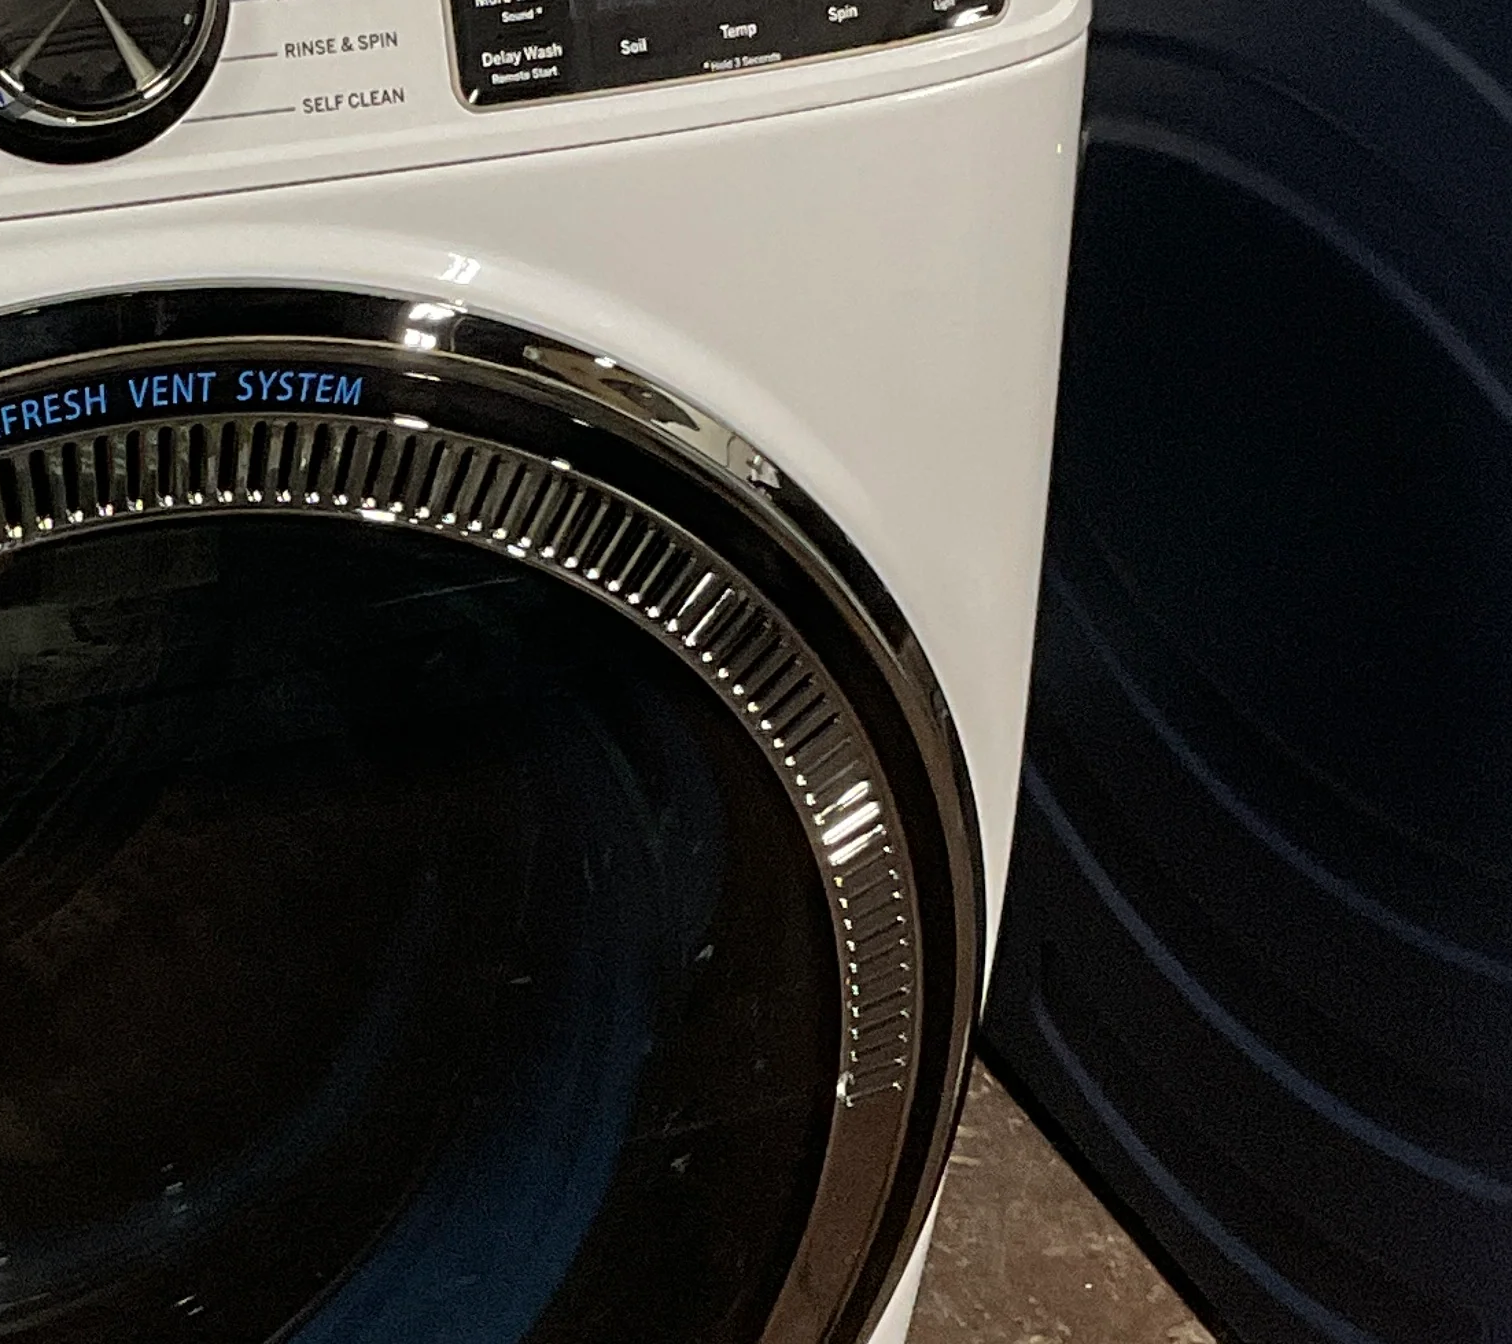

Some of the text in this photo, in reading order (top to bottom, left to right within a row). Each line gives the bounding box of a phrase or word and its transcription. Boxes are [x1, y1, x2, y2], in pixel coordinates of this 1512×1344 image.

[827, 4, 859, 23] Spin
[718, 22, 758, 39] Temp
[284, 31, 399, 59] RINSE & SPIN
[481, 42, 564, 67] Delay Wash
[620, 36, 648, 55] Soil
[734, 56, 741, 68] 3
[531, 65, 559, 80] Start
[302, 86, 406, 115] SELF CLEAN
[127, 371, 218, 410] VENT
[235, 370, 364, 407] SYSTEM
